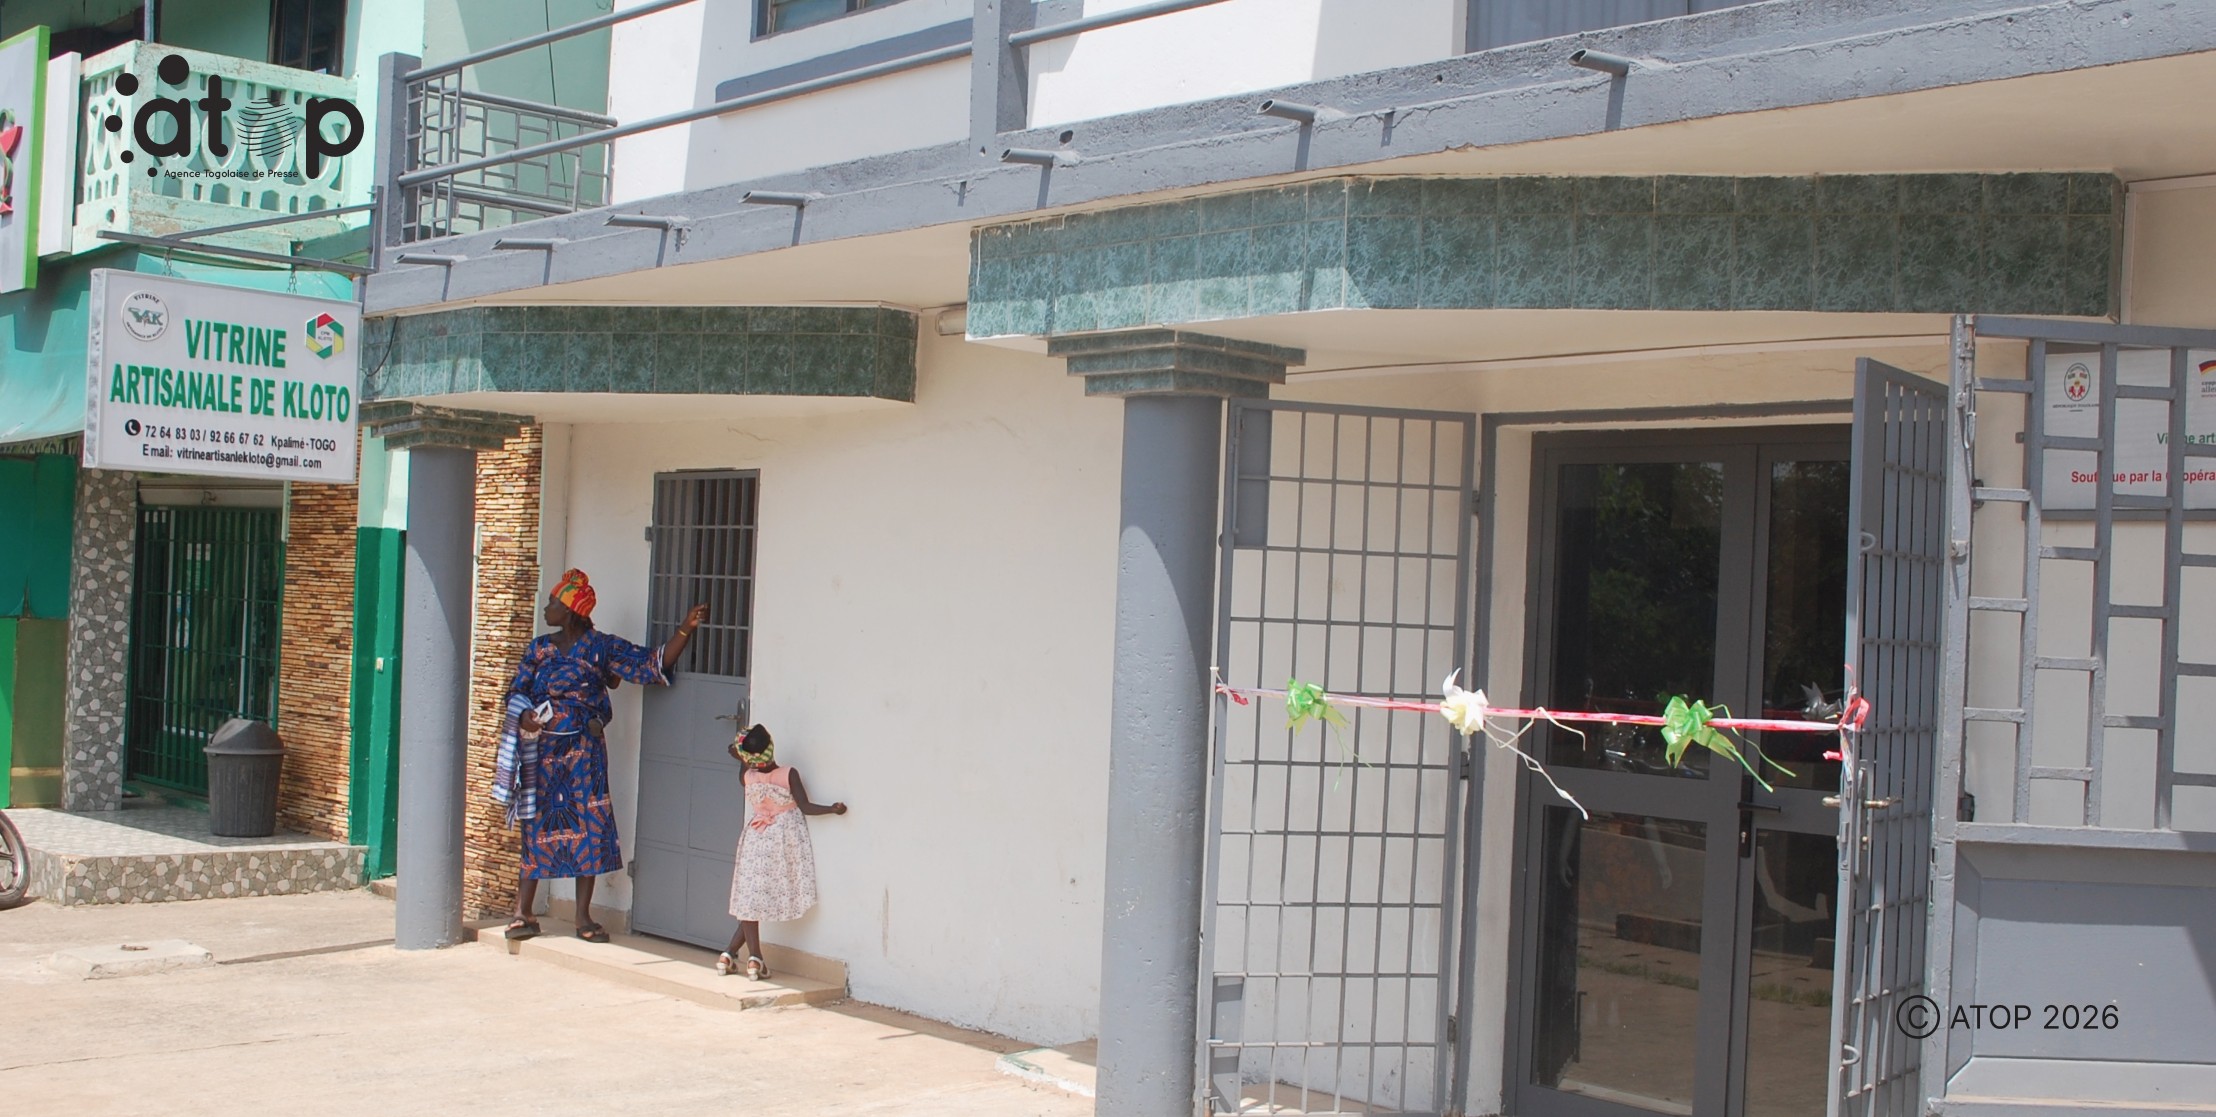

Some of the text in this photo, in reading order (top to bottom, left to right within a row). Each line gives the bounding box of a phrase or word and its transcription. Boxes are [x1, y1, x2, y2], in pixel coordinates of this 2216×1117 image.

[185, 319, 287, 368] VITRINE
[109, 363, 350, 423] ARTISANALE DE KLOTO
[145, 425, 156, 438] 72
[160, 426, 171, 439] 64
[175, 427, 187, 440] 83
[210, 430, 221, 443] 92
[224, 431, 235, 444] 66
[238, 432, 249, 445] 67
[253, 433, 264, 446] 62
[2071, 471, 2126, 483] Soutue
[2129, 473, 2149, 485] par
[2152, 470, 2162, 482] la
